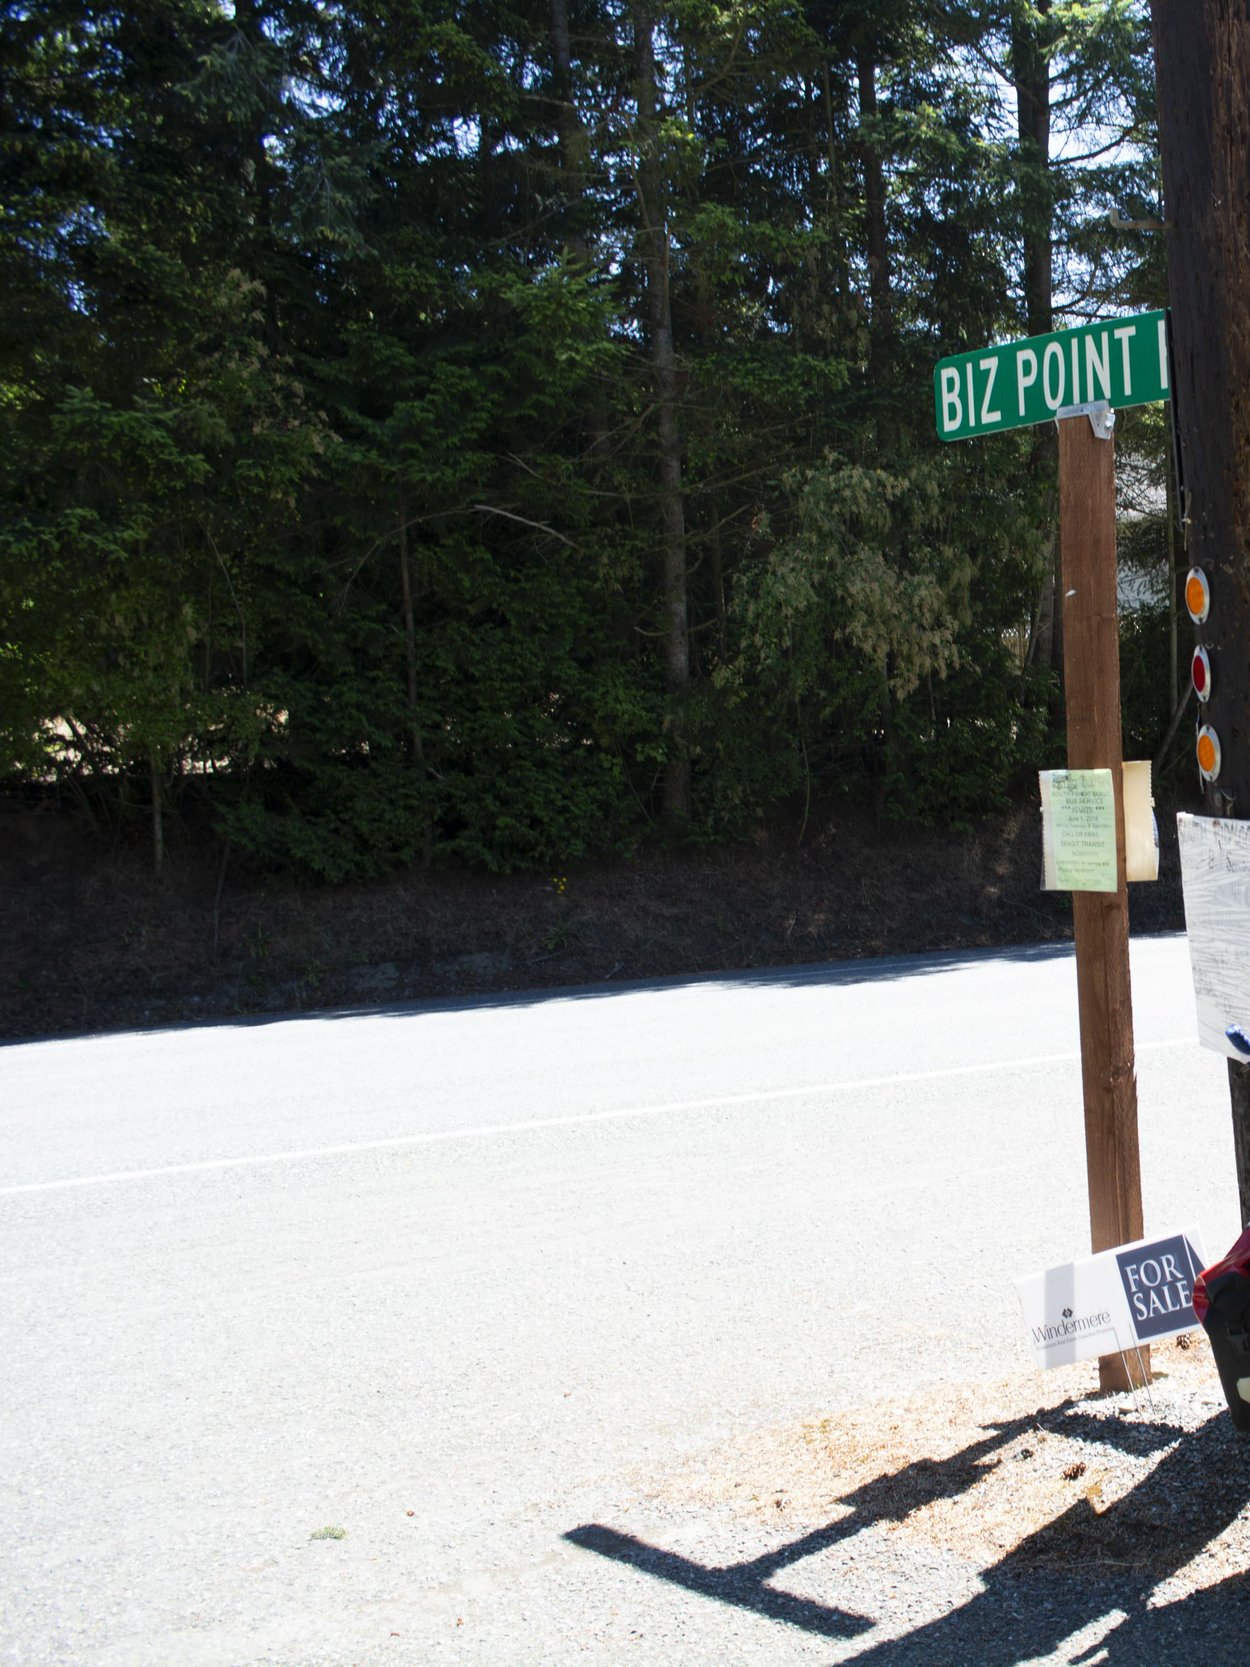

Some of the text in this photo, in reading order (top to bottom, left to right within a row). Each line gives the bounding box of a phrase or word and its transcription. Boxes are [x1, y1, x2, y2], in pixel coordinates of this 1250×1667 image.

[940, 356, 1002, 433] BIZ
[1016, 325, 1136, 417] POINT
[1079, 797, 1104, 805] SERVICE
[1081, 840, 1105, 848] TRANSIT
[1124, 1254, 1184, 1293] FOR
[1133, 1280, 1194, 1321] SALE
[1031, 1311, 1112, 1344] Windermere
